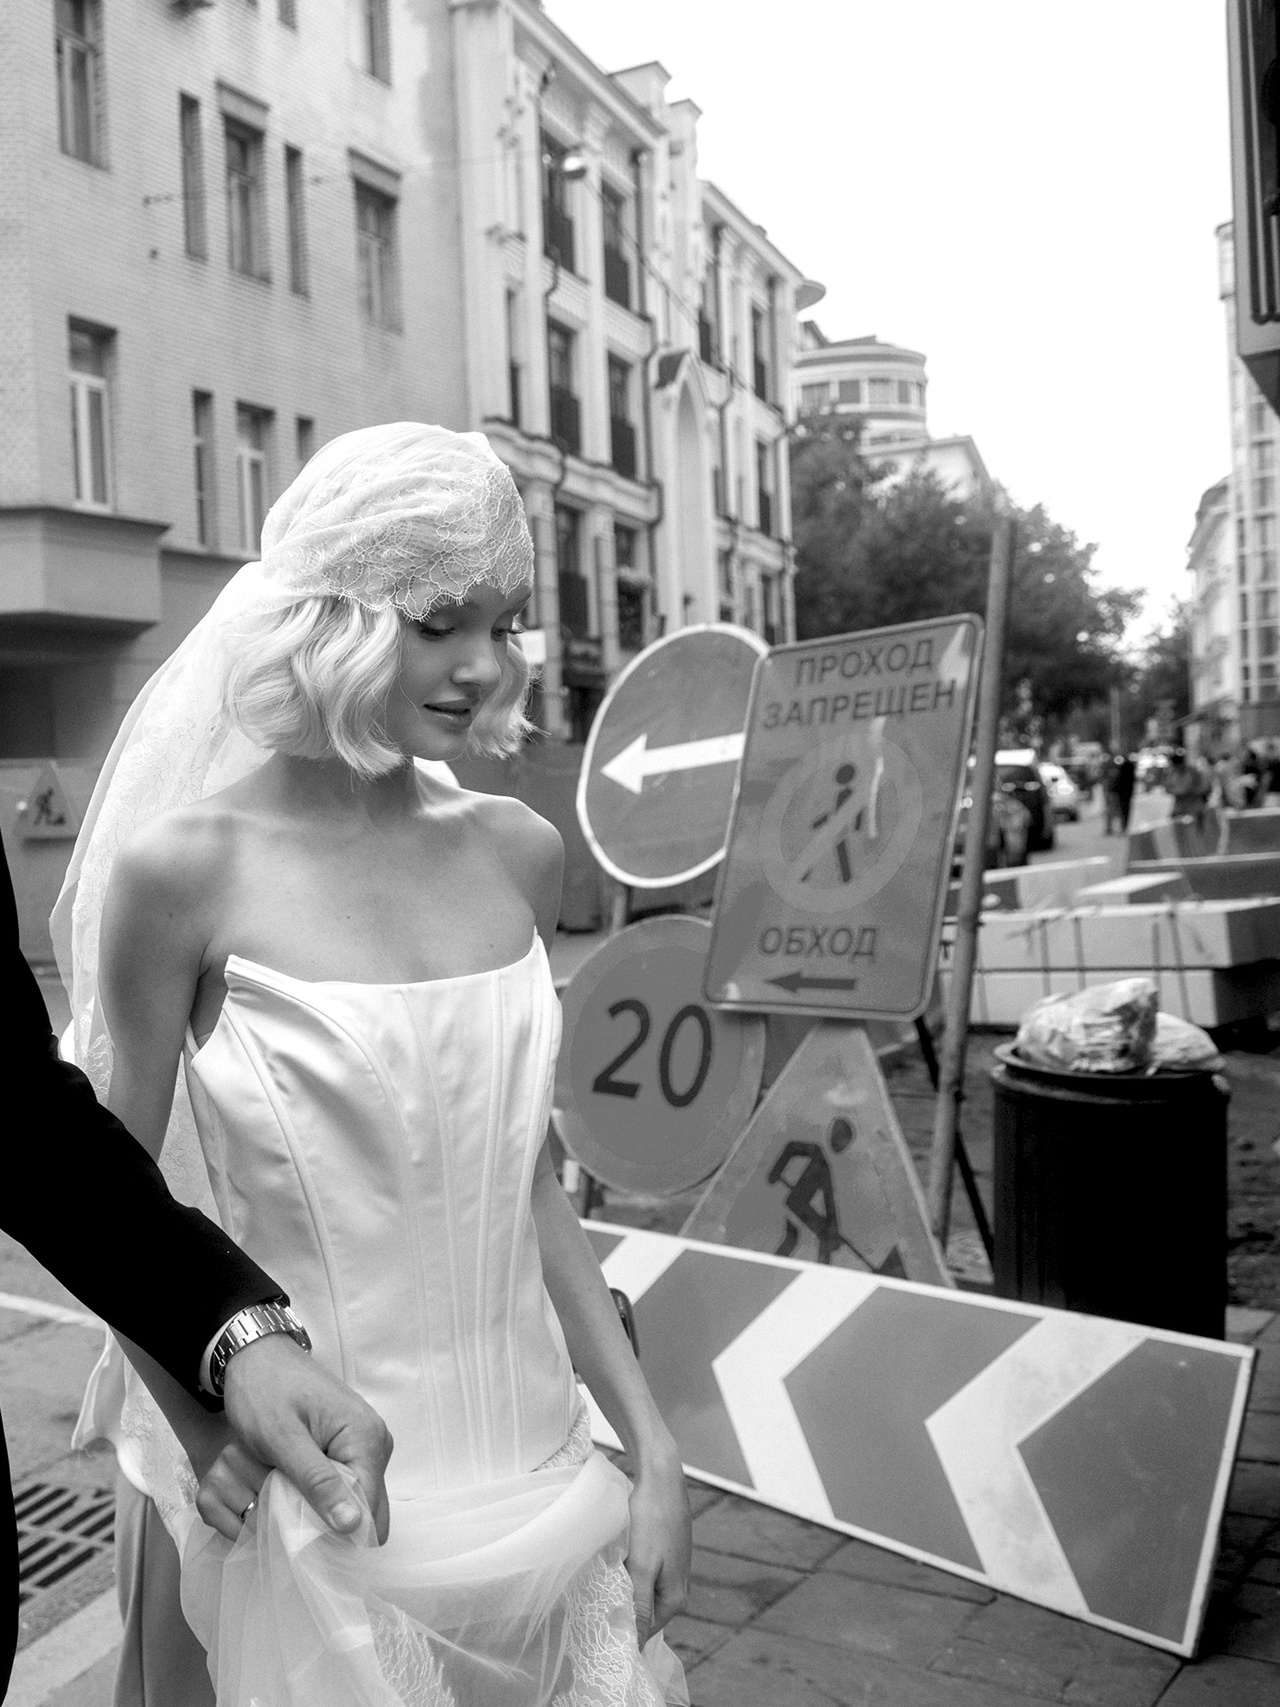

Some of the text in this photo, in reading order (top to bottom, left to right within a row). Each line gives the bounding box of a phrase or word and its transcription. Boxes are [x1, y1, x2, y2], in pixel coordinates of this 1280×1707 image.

[794, 639, 934, 687] ПРОХОД
[763, 678, 956, 730] ЗАПРЕЩЕН
[759, 926, 879, 963] ОБХОД
[592, 999, 712, 1108] 20
